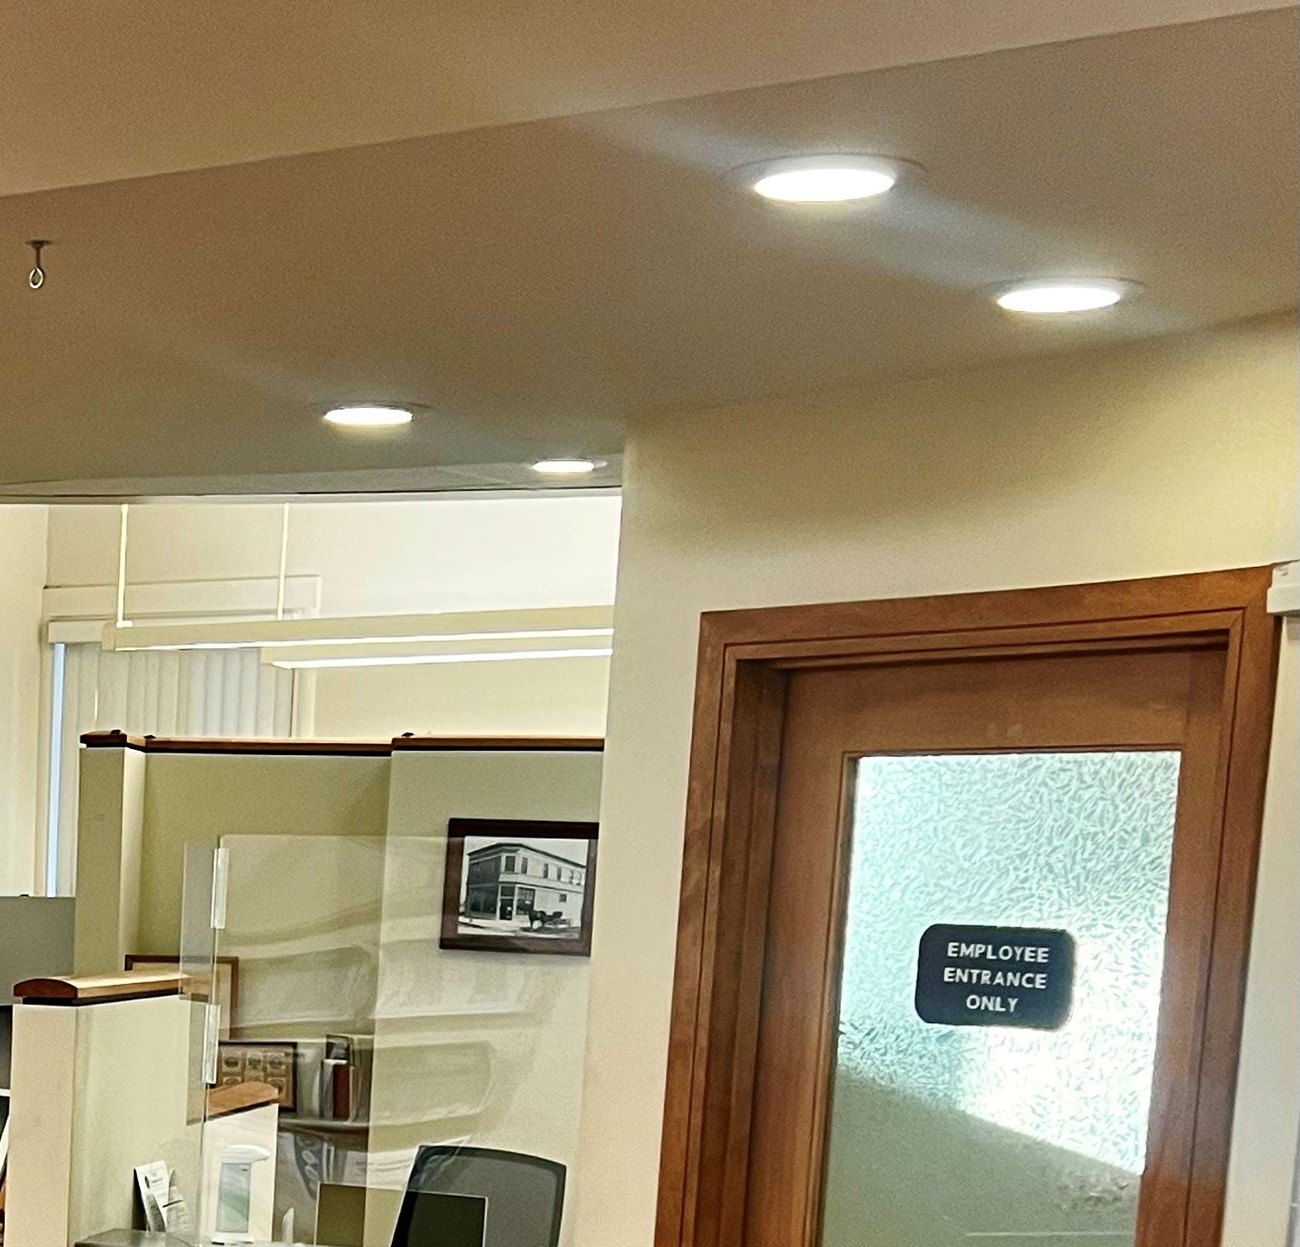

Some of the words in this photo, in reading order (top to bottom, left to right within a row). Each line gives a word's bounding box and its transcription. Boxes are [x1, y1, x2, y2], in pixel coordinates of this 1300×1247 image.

[946, 942, 1050, 963] EMPLOYEE
[943, 967, 1048, 989] ENTRANCE
[965, 995, 1019, 1013] ONLY
